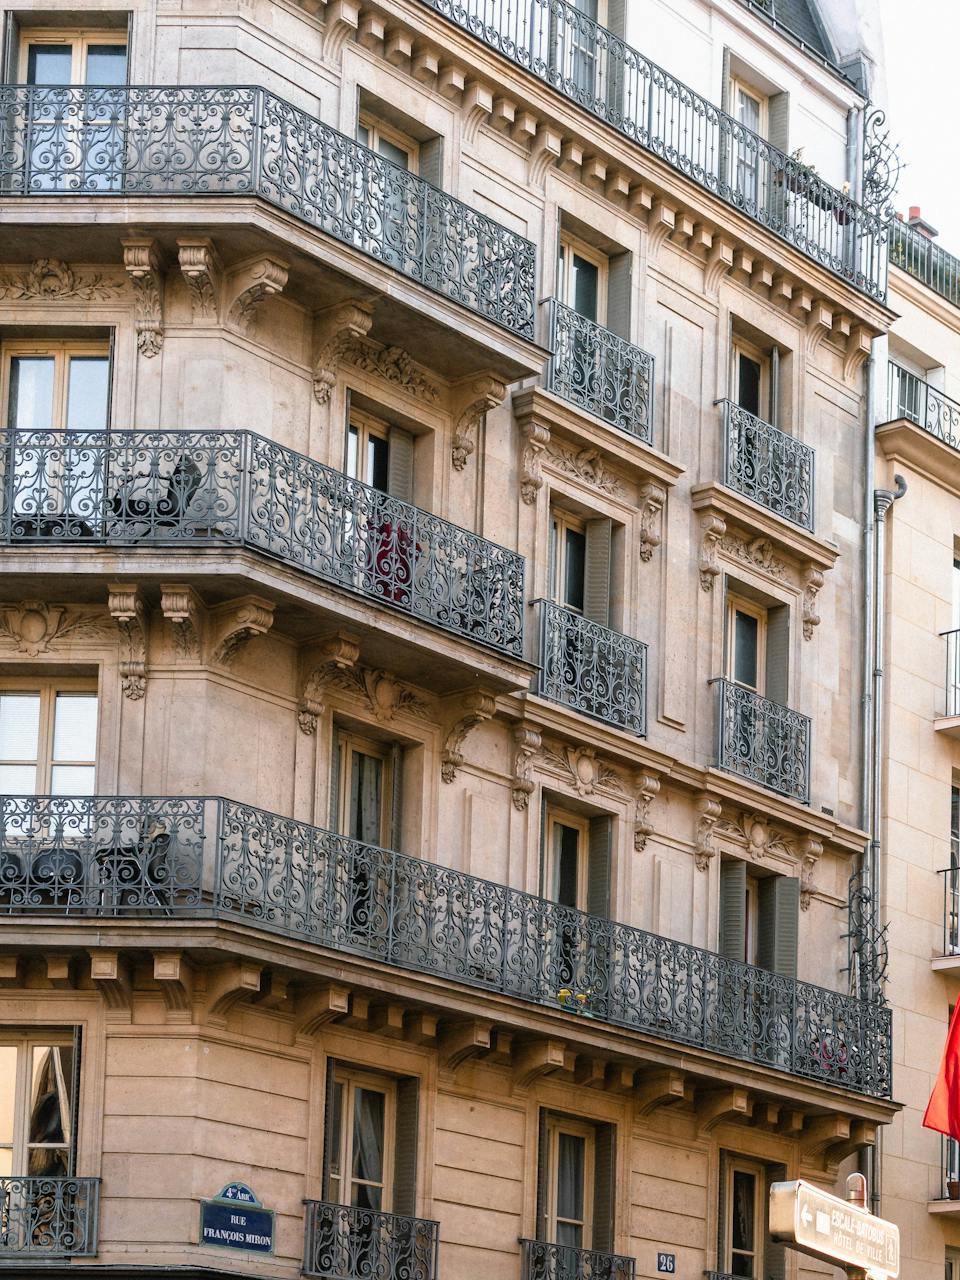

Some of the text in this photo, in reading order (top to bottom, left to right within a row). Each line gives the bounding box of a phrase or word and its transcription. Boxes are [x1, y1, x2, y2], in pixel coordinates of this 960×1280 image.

[231, 1215, 247, 1226] RUE
[203, 1228, 271, 1246] FRANÇOIS MIRON
[867, 1248, 883, 1262] VILLE
[660, 1255, 673, 1271] 26
